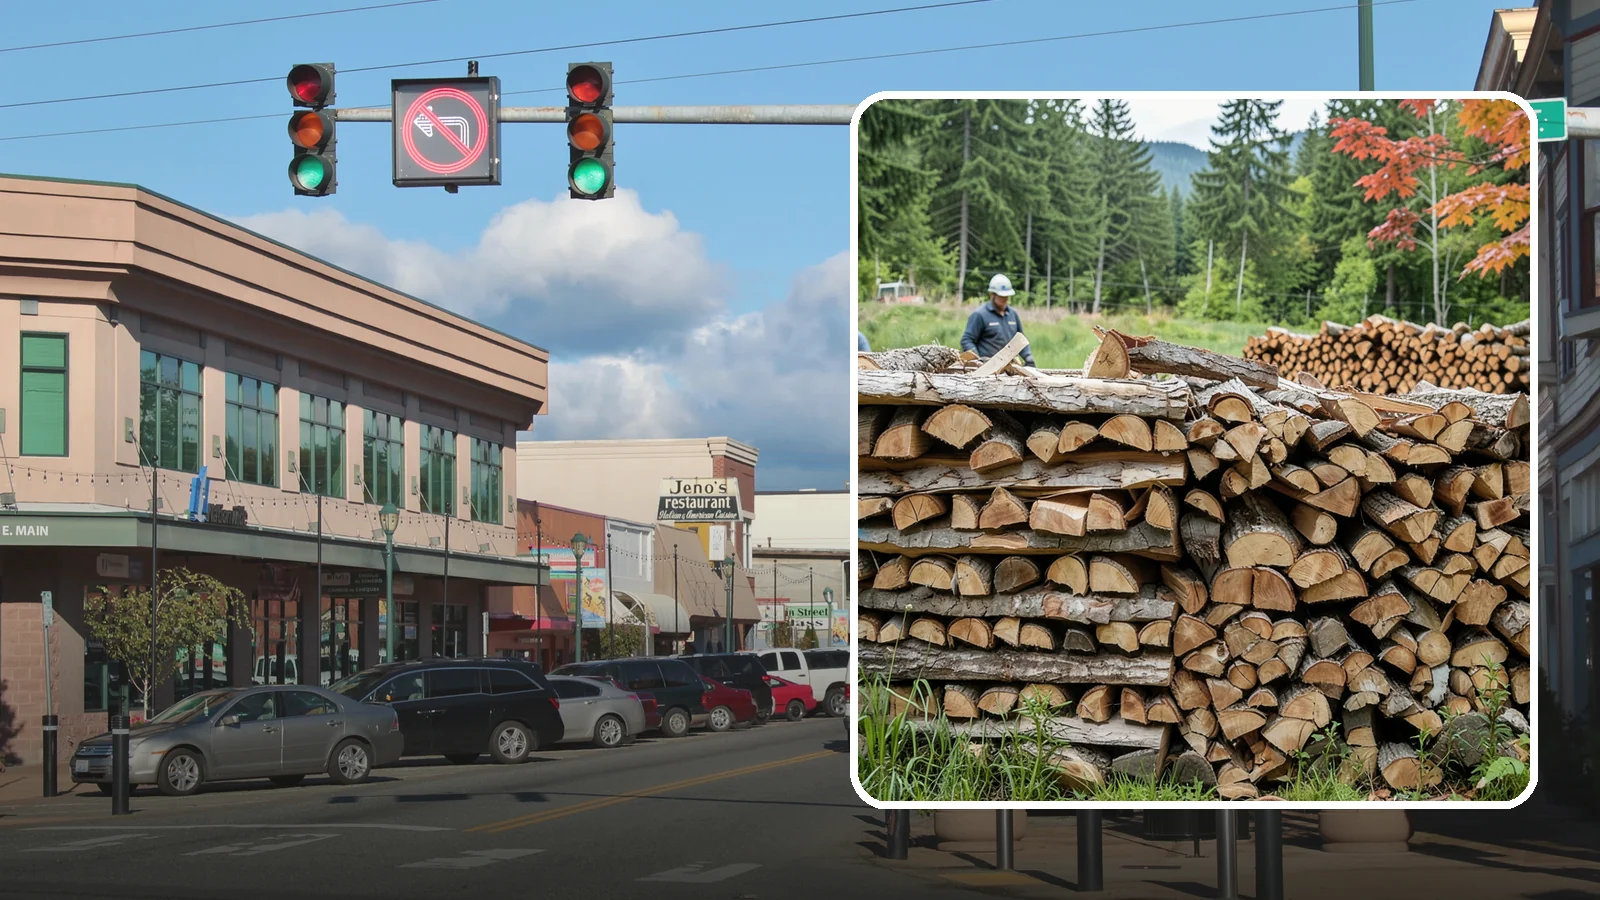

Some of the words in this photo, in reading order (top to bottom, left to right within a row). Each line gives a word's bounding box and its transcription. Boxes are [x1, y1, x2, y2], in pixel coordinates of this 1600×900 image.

[670, 480, 727, 494] Jeno's
[665, 496, 731, 509] restaurant
[685, 509, 715, 519] American
[715, 509, 737, 519] Cuisine
[2, 525, 13, 536] E.
[15, 525, 49, 536] MAIN
[797, 607, 829, 617] Street
